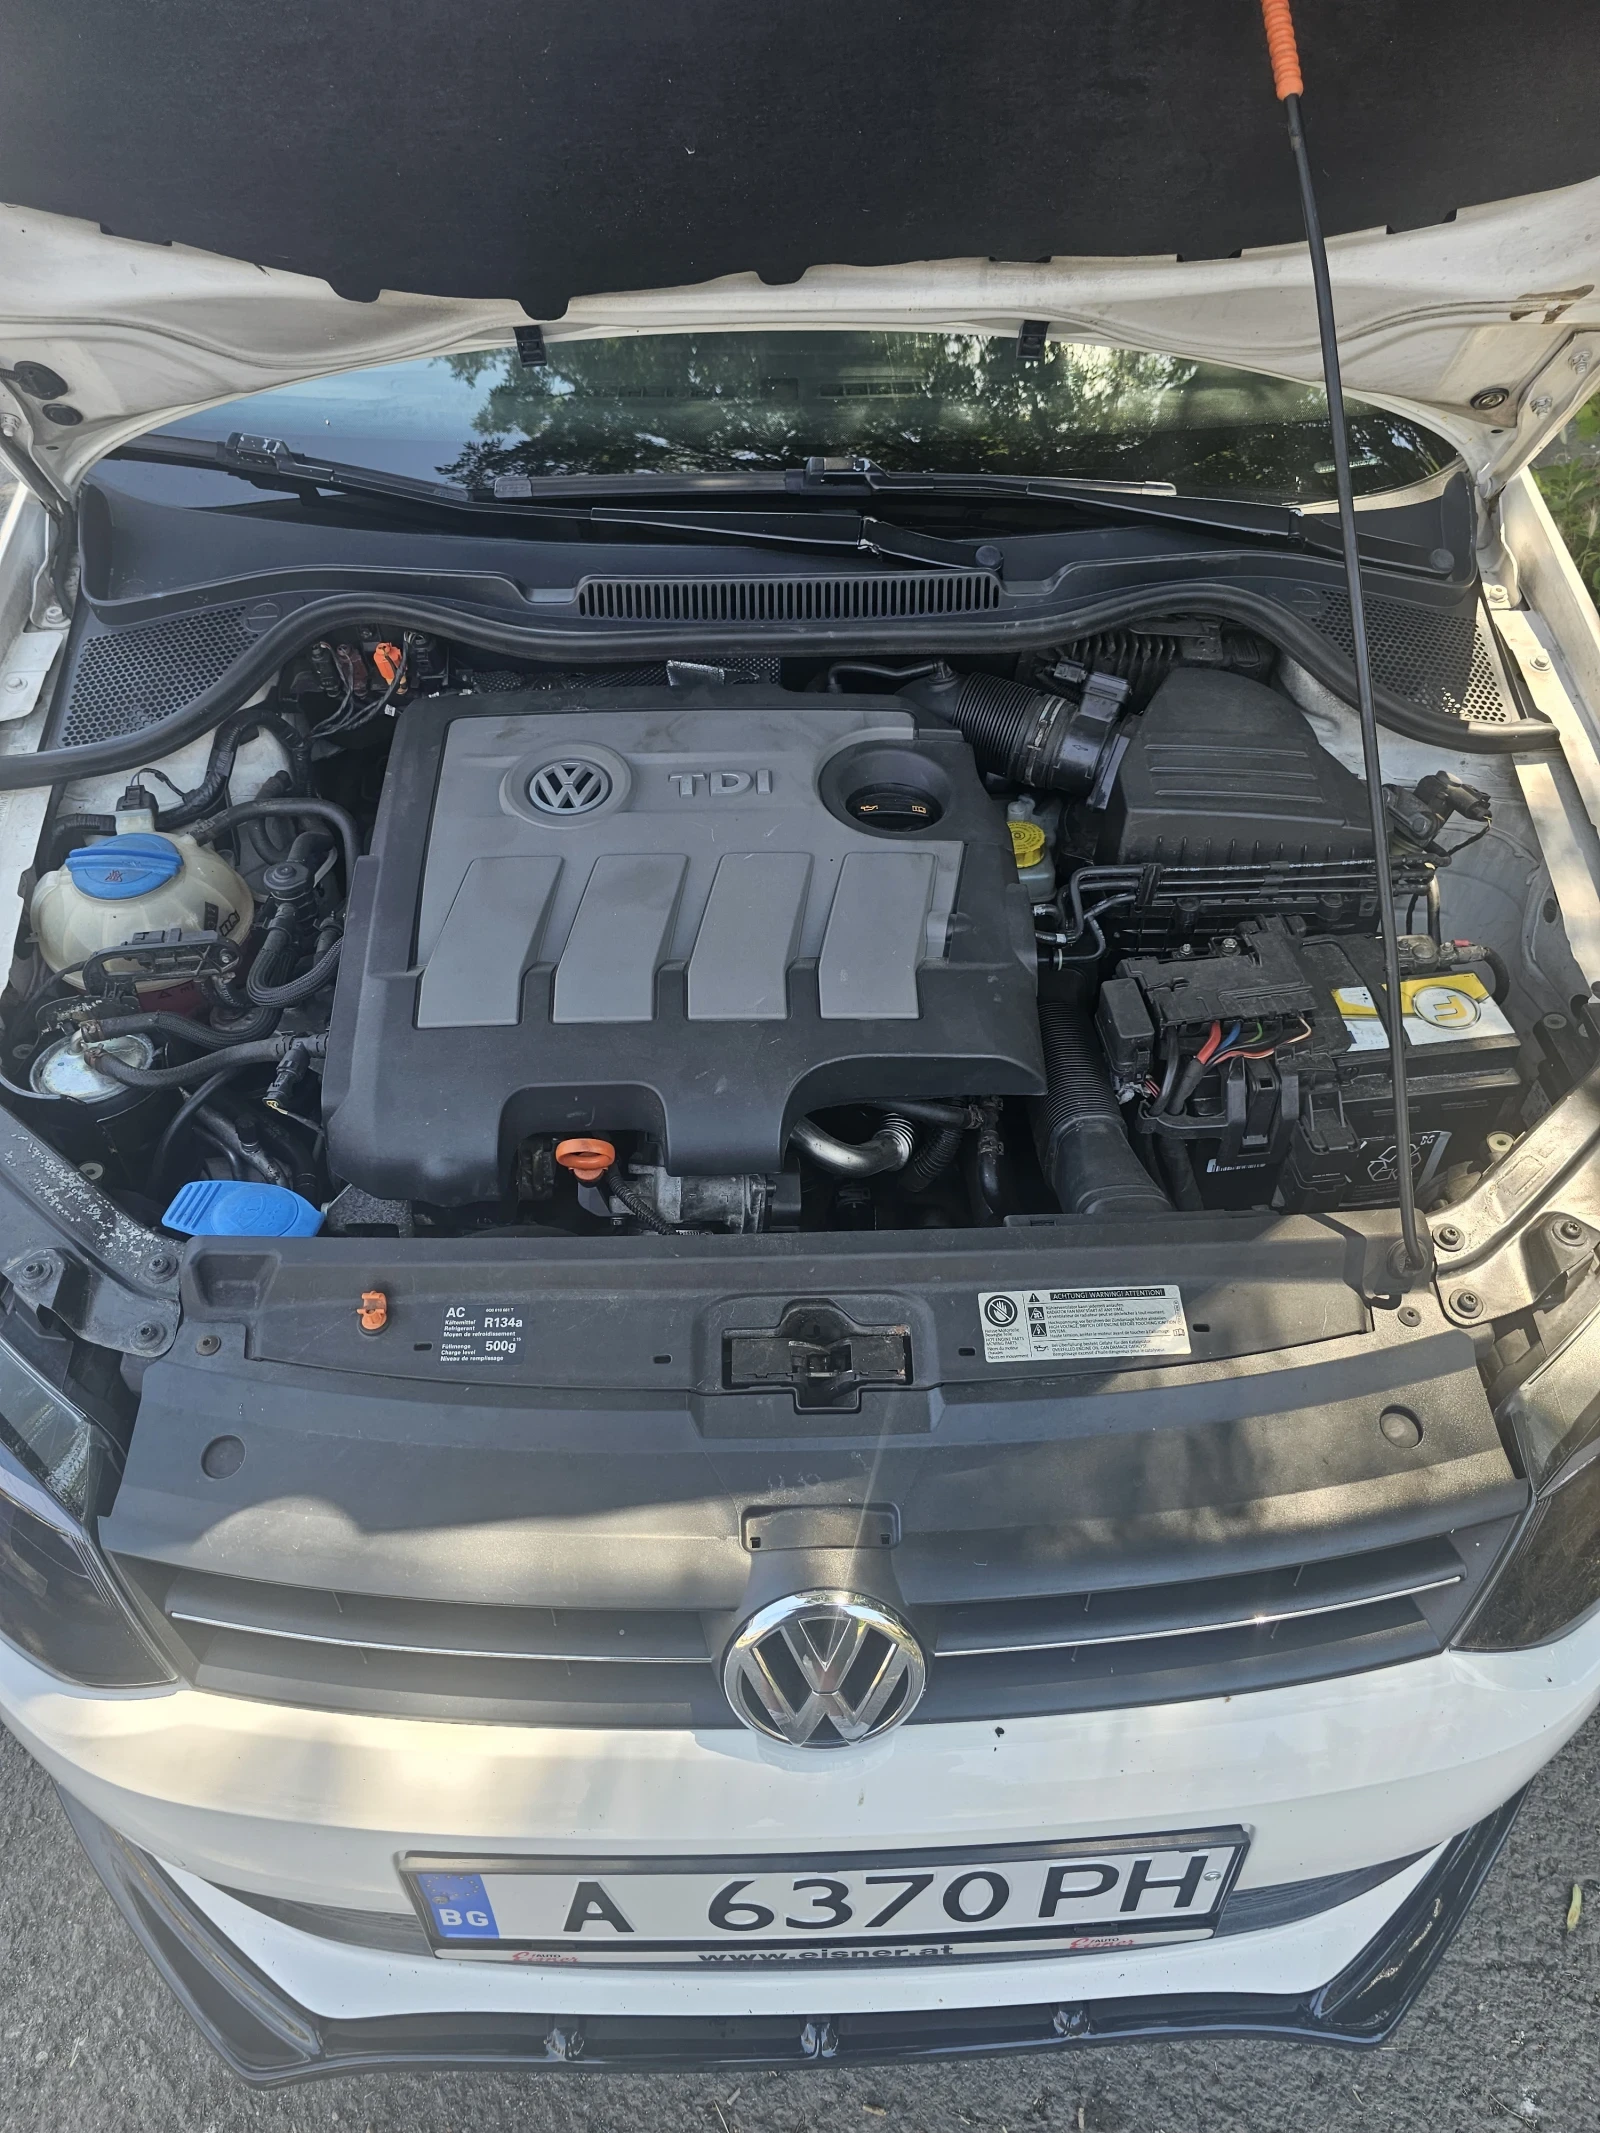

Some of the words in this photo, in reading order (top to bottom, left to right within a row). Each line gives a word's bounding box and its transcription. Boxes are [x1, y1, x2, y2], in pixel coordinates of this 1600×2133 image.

[667, 768, 773, 798] TDI
[446, 1307, 466, 1318] AC
[484, 1317, 522, 1328] R134a
[485, 1341, 516, 1353] 500g
[563, 1881, 635, 1933] A
[708, 1869, 1014, 1932] 6370
[1039, 1855, 1210, 1917] PH
[439, 1908, 489, 1927] BG
[698, 1944, 953, 1962] www.eisner.at
